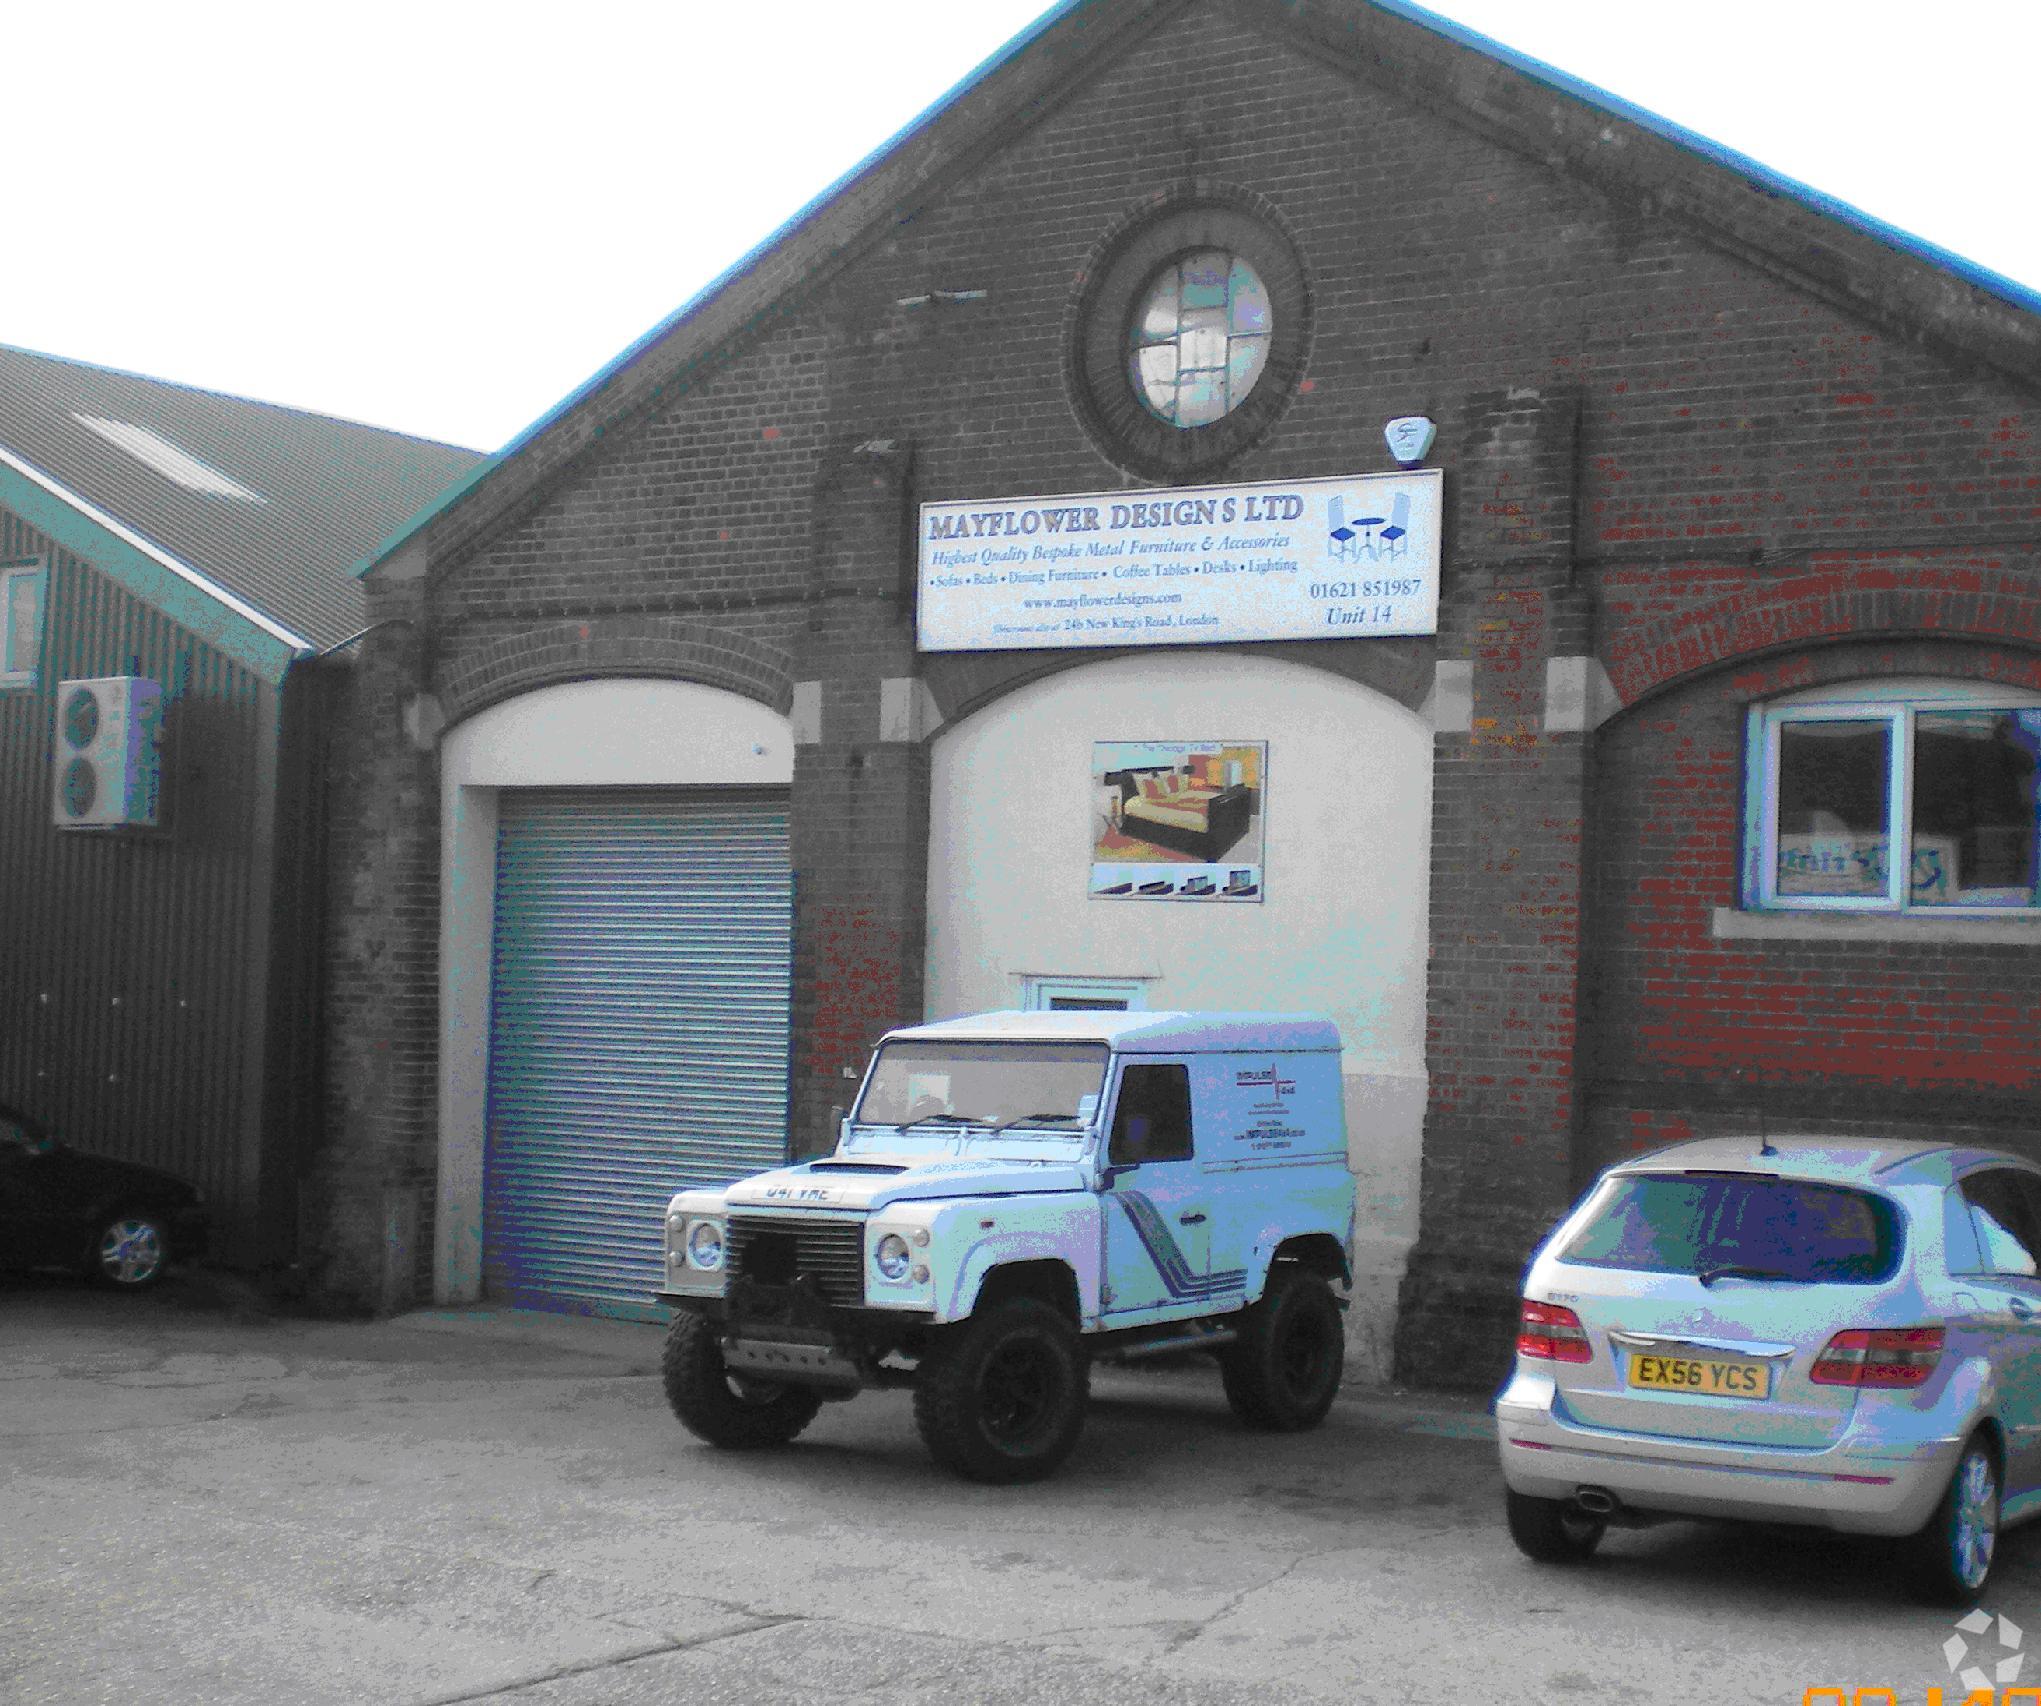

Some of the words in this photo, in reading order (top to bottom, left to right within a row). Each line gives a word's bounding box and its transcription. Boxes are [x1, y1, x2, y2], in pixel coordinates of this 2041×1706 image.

[929, 507, 1100, 540] MAYFLOWER
[1244, 494, 1304, 522] LTD
[932, 551, 976, 568] Highest
[981, 546, 1027, 566] Quality
[1032, 543, 1081, 562] Bespoke
[1085, 540, 1125, 557] Metal
[1129, 538, 1197, 555] Furniture
[1201, 536, 1214, 550] &
[1217, 532, 1290, 551] Accessories
[936, 575, 962, 587] Sofas
[973, 573, 998, 585] Beds
[1009, 571, 1045, 584] Dining
[1049, 568, 1099, 582] Furniture
[1113, 564, 1150, 578] Coffee
[1152, 562, 1191, 577] Tables
[1202, 560, 1237, 574] Desks
[1248, 557, 1298, 575] Lighting
[1310, 582, 1356, 599] 01621
[1363, 579, 1421, 597] 851987
[1179, 613, 1219, 626] London
[1327, 605, 1366, 625] Unit
[1373, 604, 1392, 624] 14
[1640, 1357, 1702, 1386] EX56
[1711, 1363, 1758, 1391] YCS
